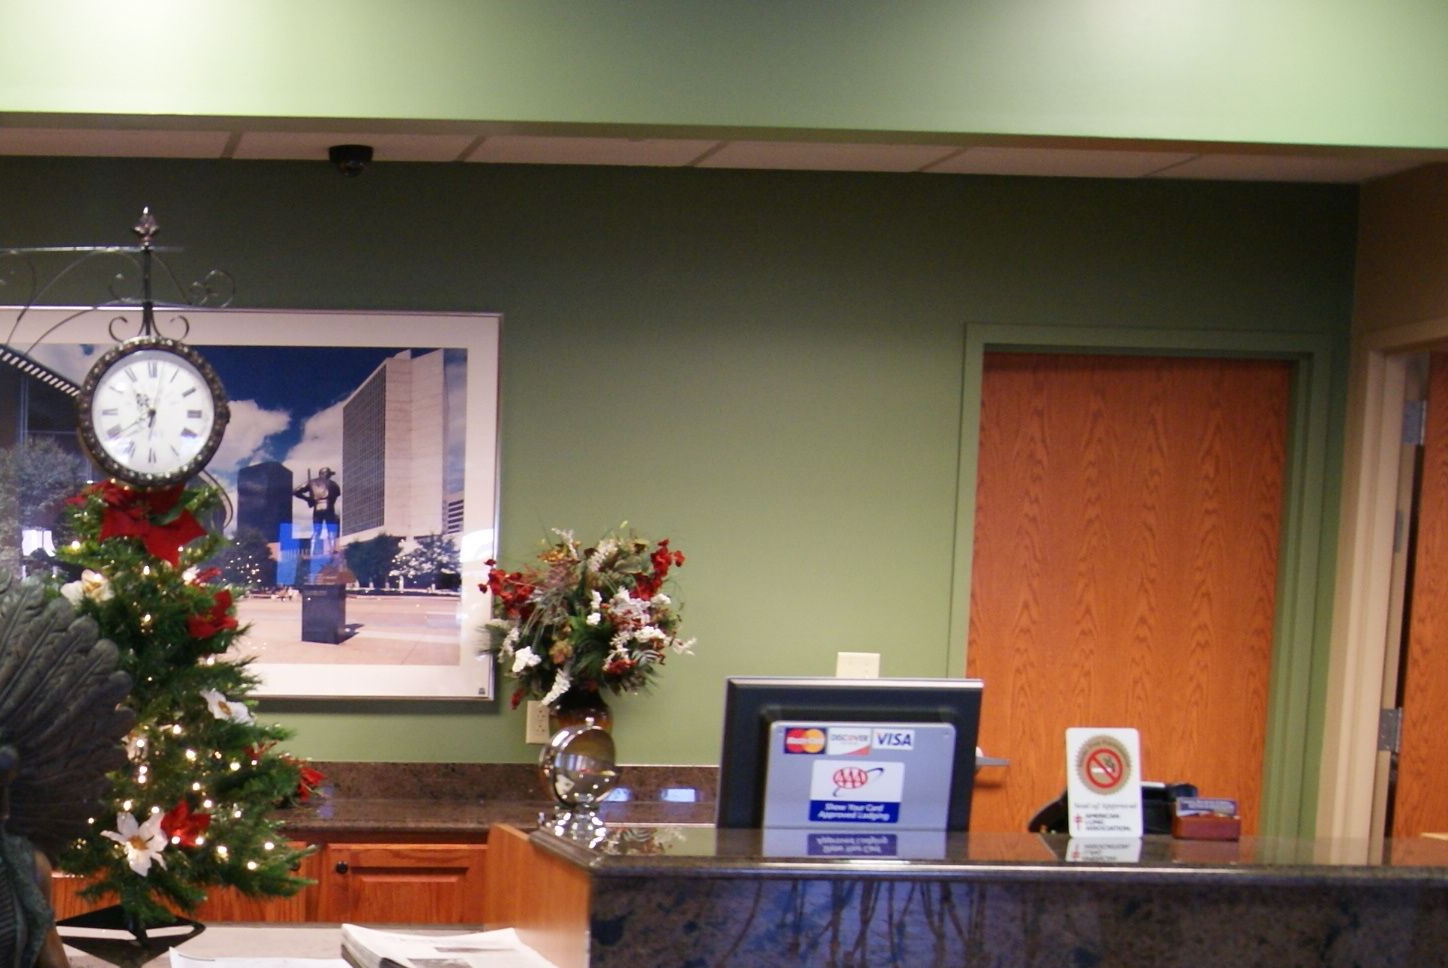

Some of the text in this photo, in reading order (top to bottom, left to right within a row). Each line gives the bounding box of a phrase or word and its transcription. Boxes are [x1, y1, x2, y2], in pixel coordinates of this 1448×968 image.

[877, 732, 912, 746] VISA
[833, 767, 867, 789] AAA
[825, 803, 885, 812] Show Your Card
